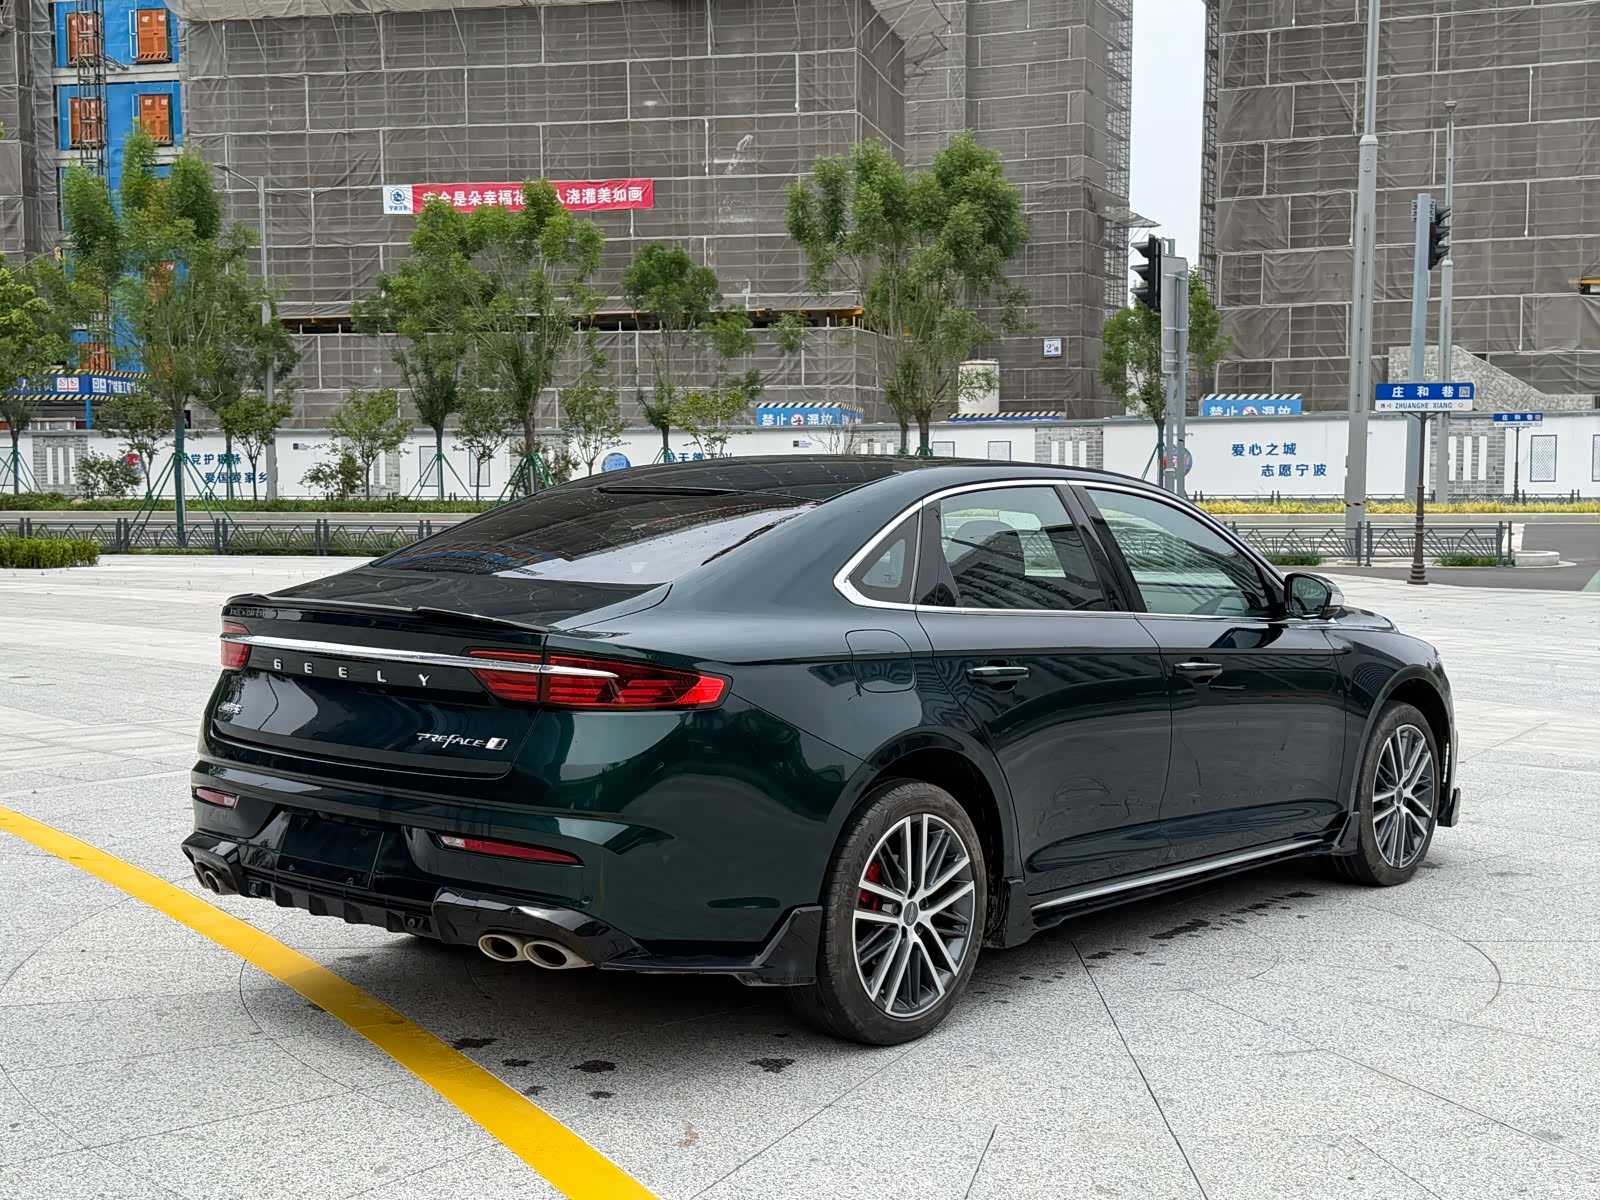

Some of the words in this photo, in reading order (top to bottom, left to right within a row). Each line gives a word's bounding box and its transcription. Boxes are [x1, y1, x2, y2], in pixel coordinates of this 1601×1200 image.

[1392, 386, 1454, 398] 庄和巷
[762, 413, 788, 426] 禁止
[1231, 442, 1297, 457] 爱心之城
[1261, 463, 1327, 477] 志愿宁波
[204, 471, 268, 484] 爱国爱家乡
[273, 658, 430, 687] GEELY
